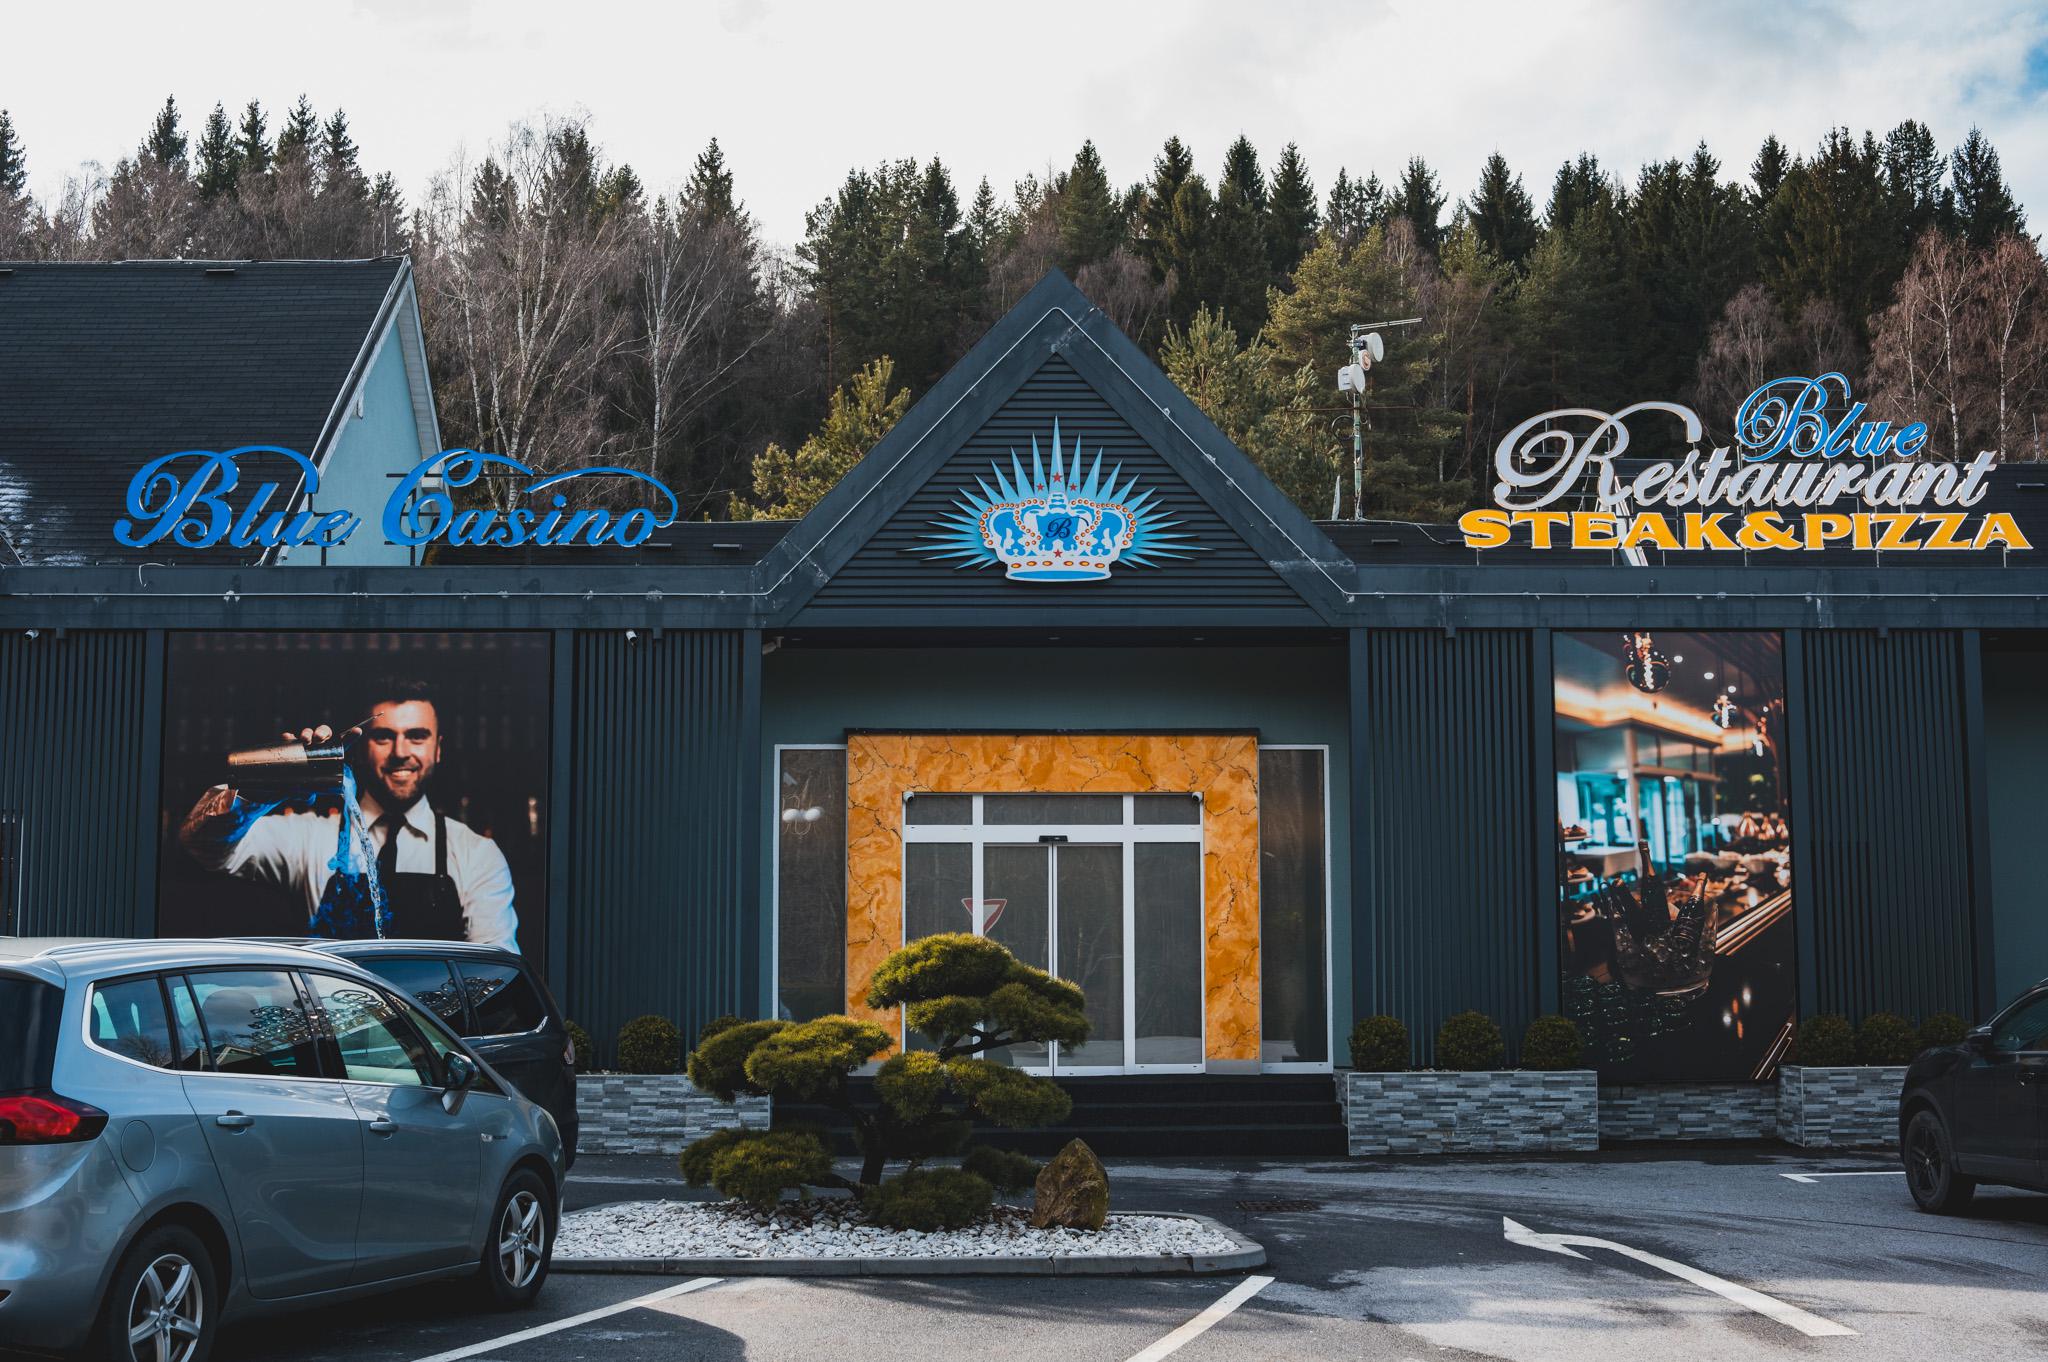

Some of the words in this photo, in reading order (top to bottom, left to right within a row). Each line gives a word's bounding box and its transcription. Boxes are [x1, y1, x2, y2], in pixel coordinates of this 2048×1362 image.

[1493, 401, 1998, 510] Restaurant
[1735, 371, 1928, 462] Blue
[112, 445, 361, 548] Blue
[382, 448, 678, 547] Casino
[1045, 516, 1089, 539] B
[1457, 509, 2034, 550] STEAK&PIZZA
